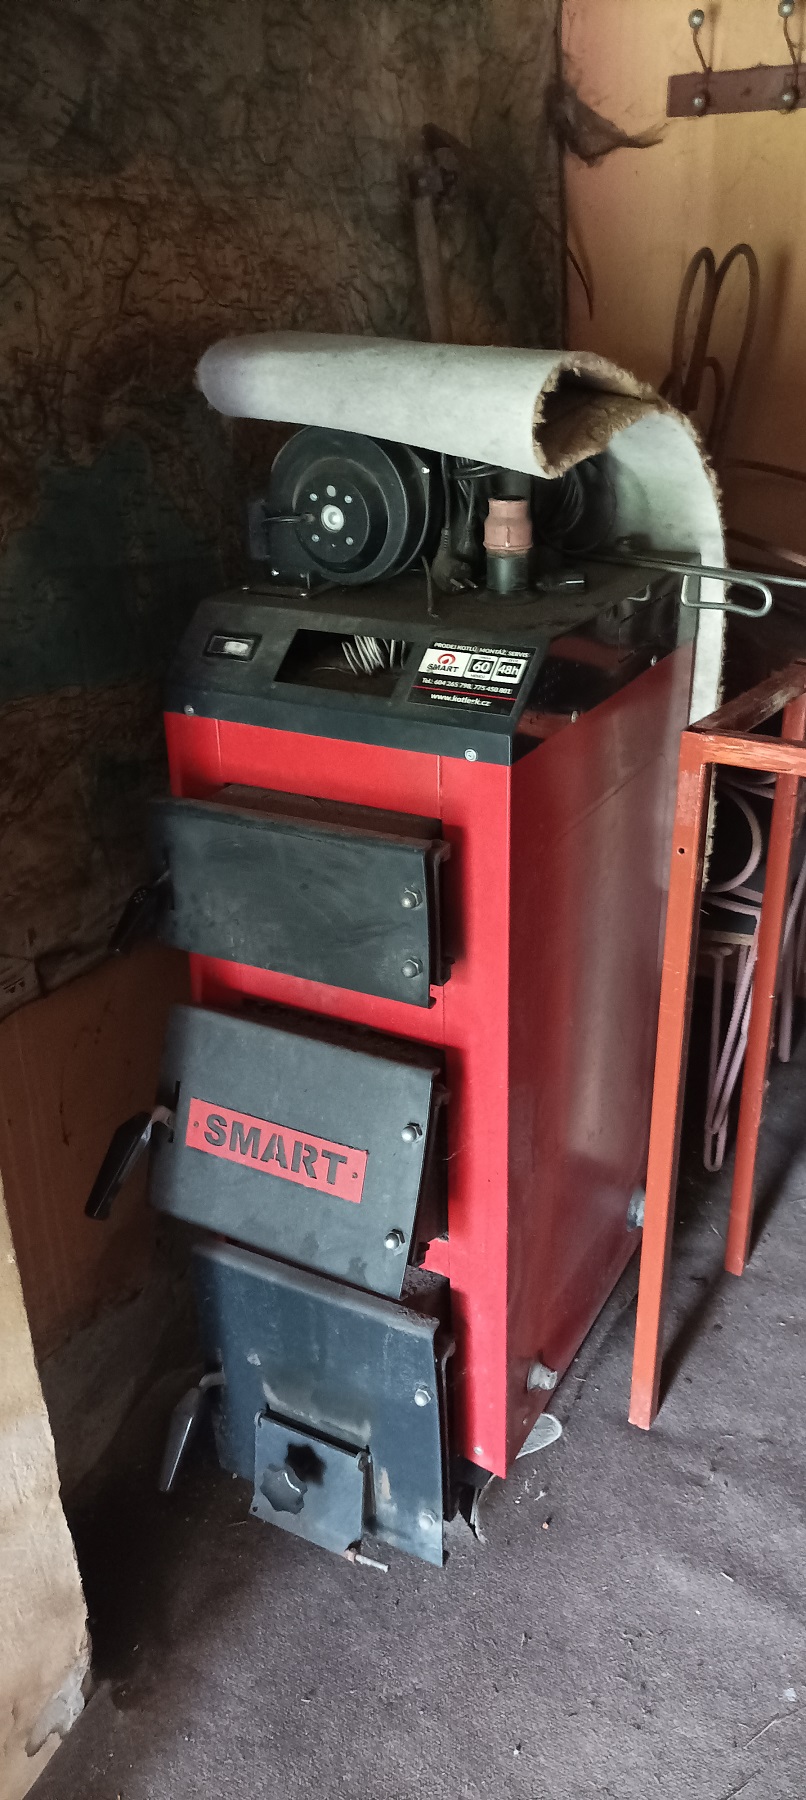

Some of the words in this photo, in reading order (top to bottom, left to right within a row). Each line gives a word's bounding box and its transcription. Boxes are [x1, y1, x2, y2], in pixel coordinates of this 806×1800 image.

[434, 642, 457, 650] PRODEJ
[427, 664, 459, 673] SMART
[472, 661, 491, 672] 60
[498, 664, 519, 676] 48h
[204, 1114, 348, 1185] SMART
